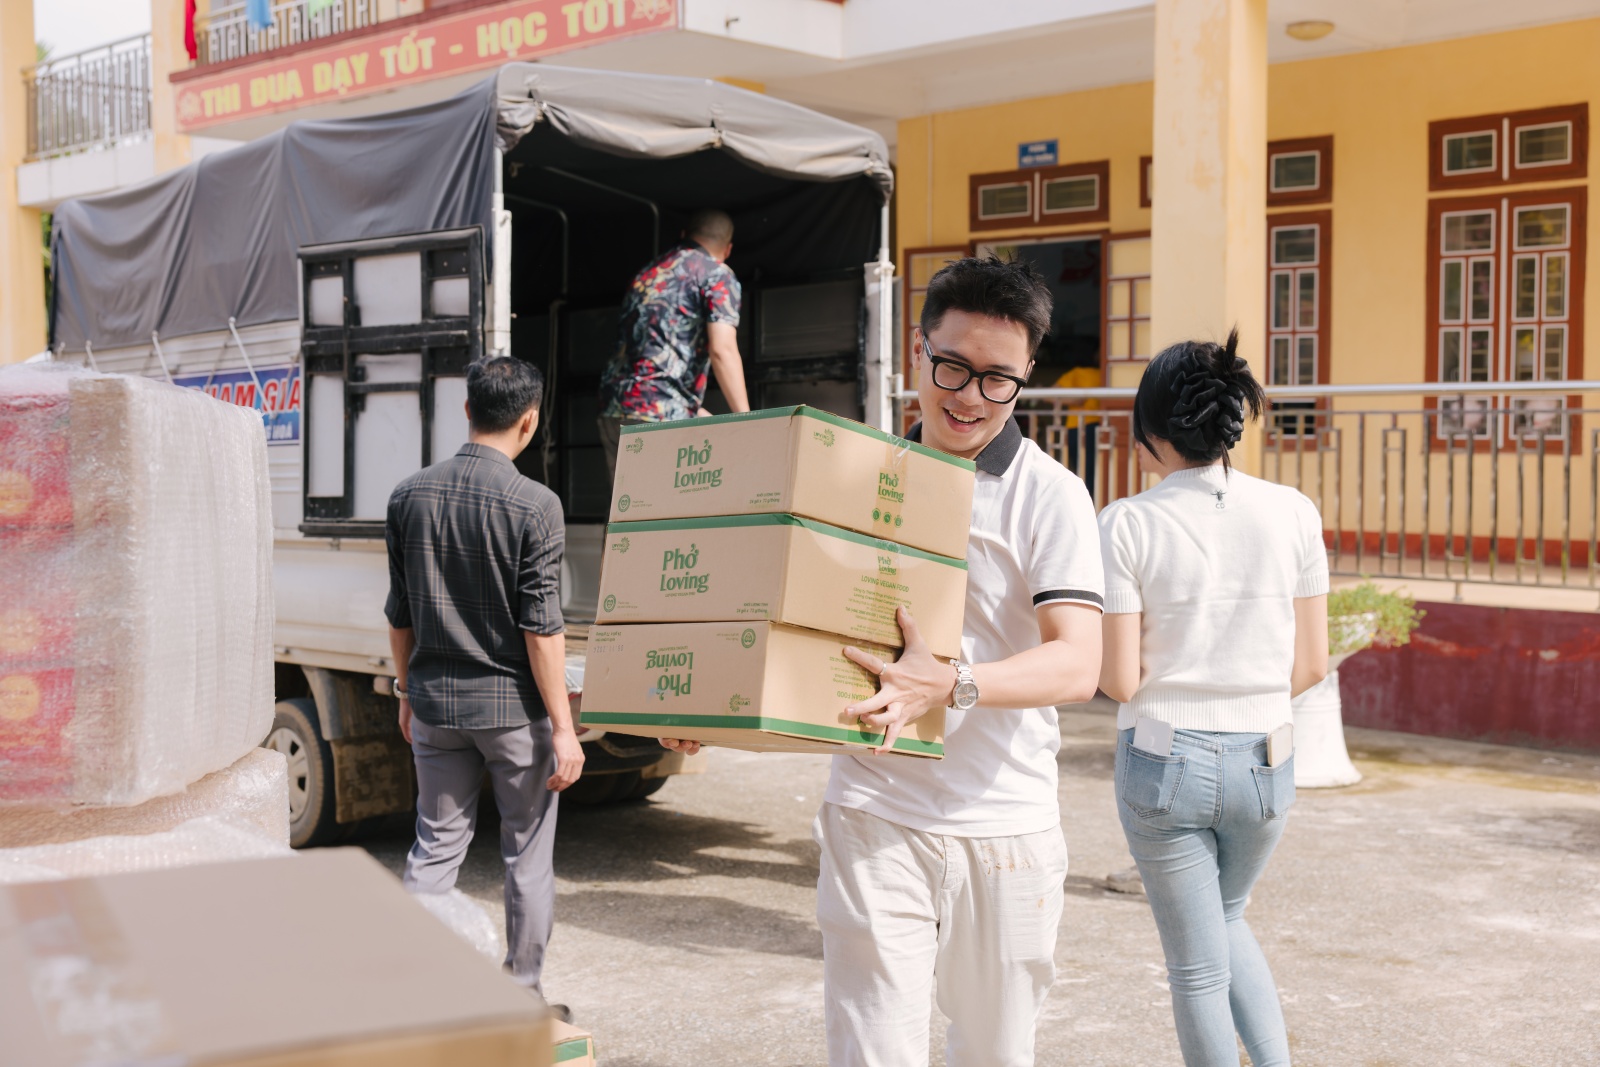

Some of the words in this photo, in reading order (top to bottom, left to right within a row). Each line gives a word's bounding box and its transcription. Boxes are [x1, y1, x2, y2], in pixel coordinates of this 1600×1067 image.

[201, 83, 241, 118] THI
[312, 53, 369, 95] DẠY
[380, 29, 436, 78] TỐT
[476, 11, 548, 58] HỌC
[676, 439, 713, 468] Phở
[674, 467, 723, 488] Loving
[878, 485, 904, 503] Loving
[662, 543, 699, 571] Phở
[660, 571, 710, 593] Loving
[861, 575, 880, 586] LOVING
[880, 580, 896, 590] VEGAN
[897, 583, 910, 593] FOOD
[645, 650, 694, 672] Loving
[837, 691, 850, 699] FOOD
